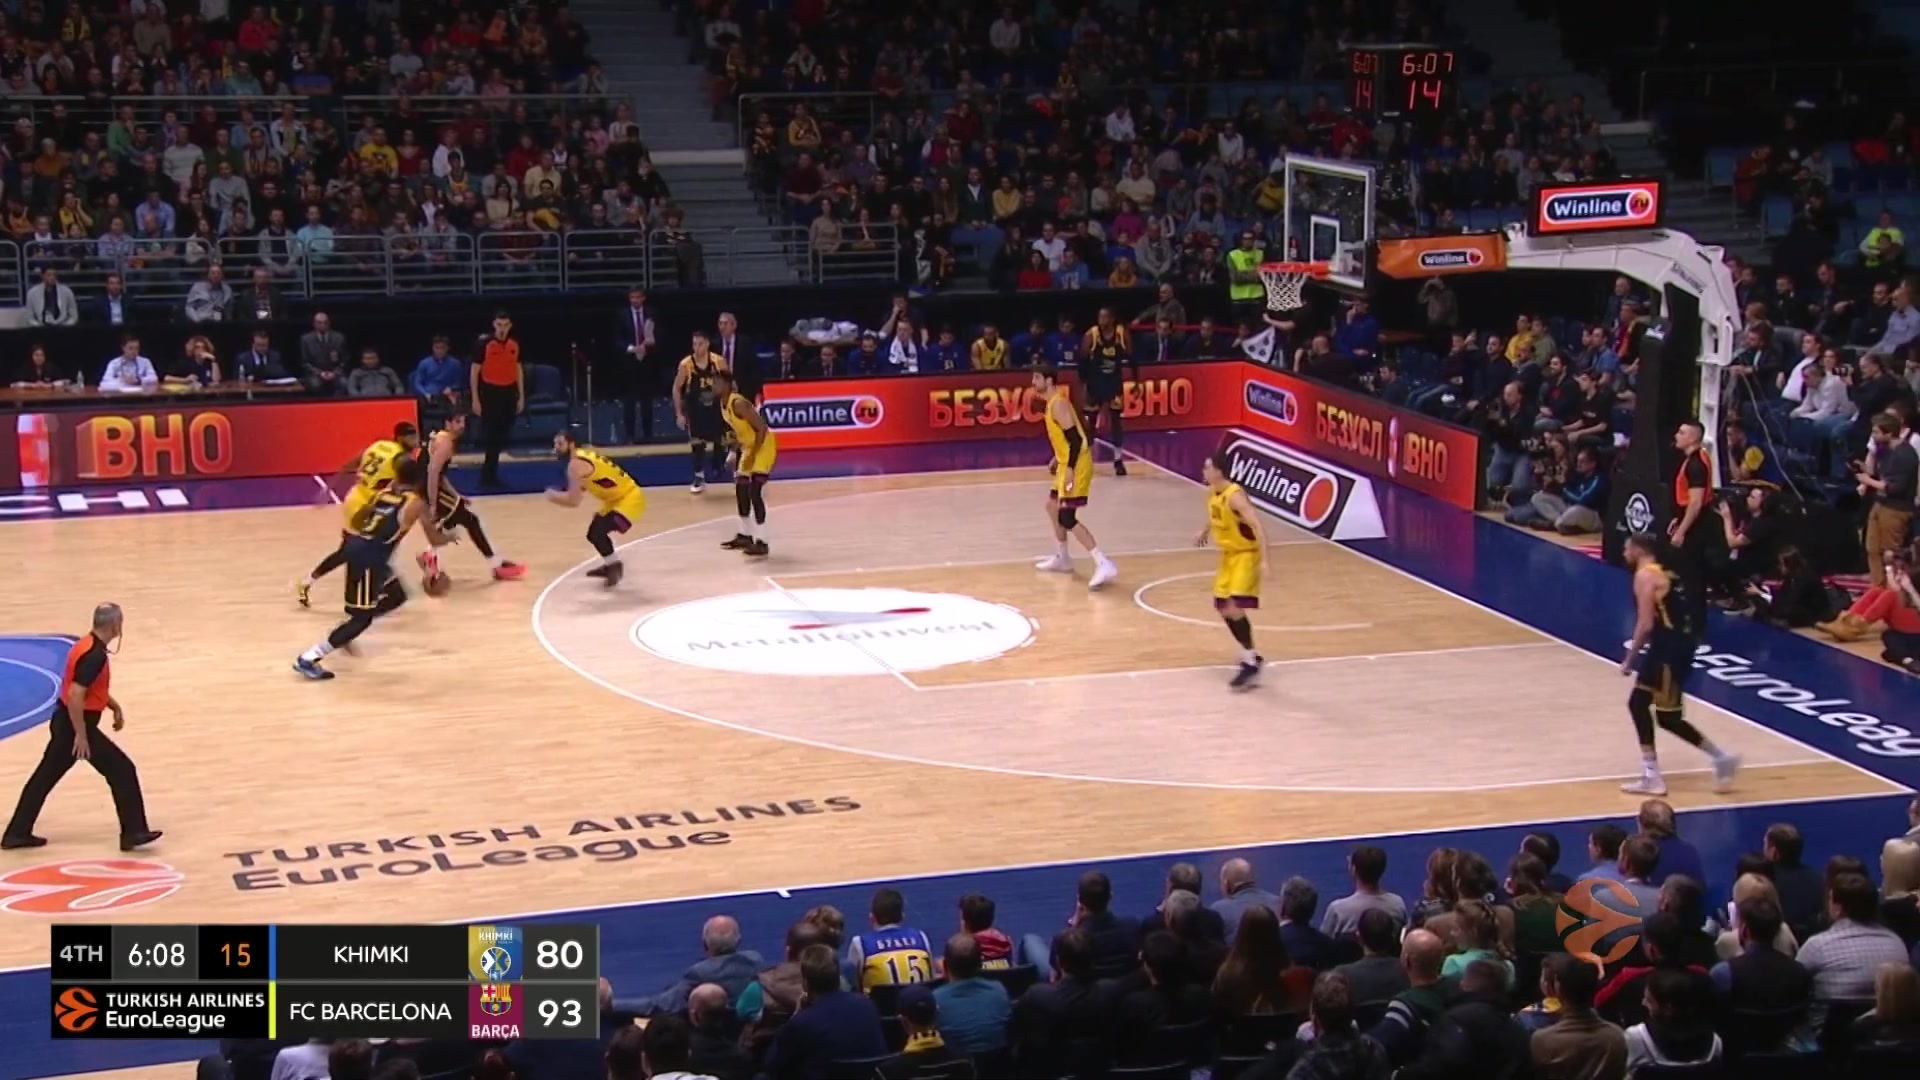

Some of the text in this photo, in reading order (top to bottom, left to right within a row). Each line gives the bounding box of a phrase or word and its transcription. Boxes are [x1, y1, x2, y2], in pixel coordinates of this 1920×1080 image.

[1402, 52, 1453, 75] 6:07
[1409, 80, 1441, 110] 14
[1554, 198, 1621, 217] Winline
[1424, 254, 1464, 265] Winline
[765, 406, 847, 424] Winline
[76, 411, 233, 478] ВНО
[1316, 401, 1448, 483] БЕЗУСЛ ВНО
[1229, 452, 1301, 505] Winline
[224, 795, 862, 868] TURKISH AIRLINES
[231, 828, 732, 892] EuroLeague
